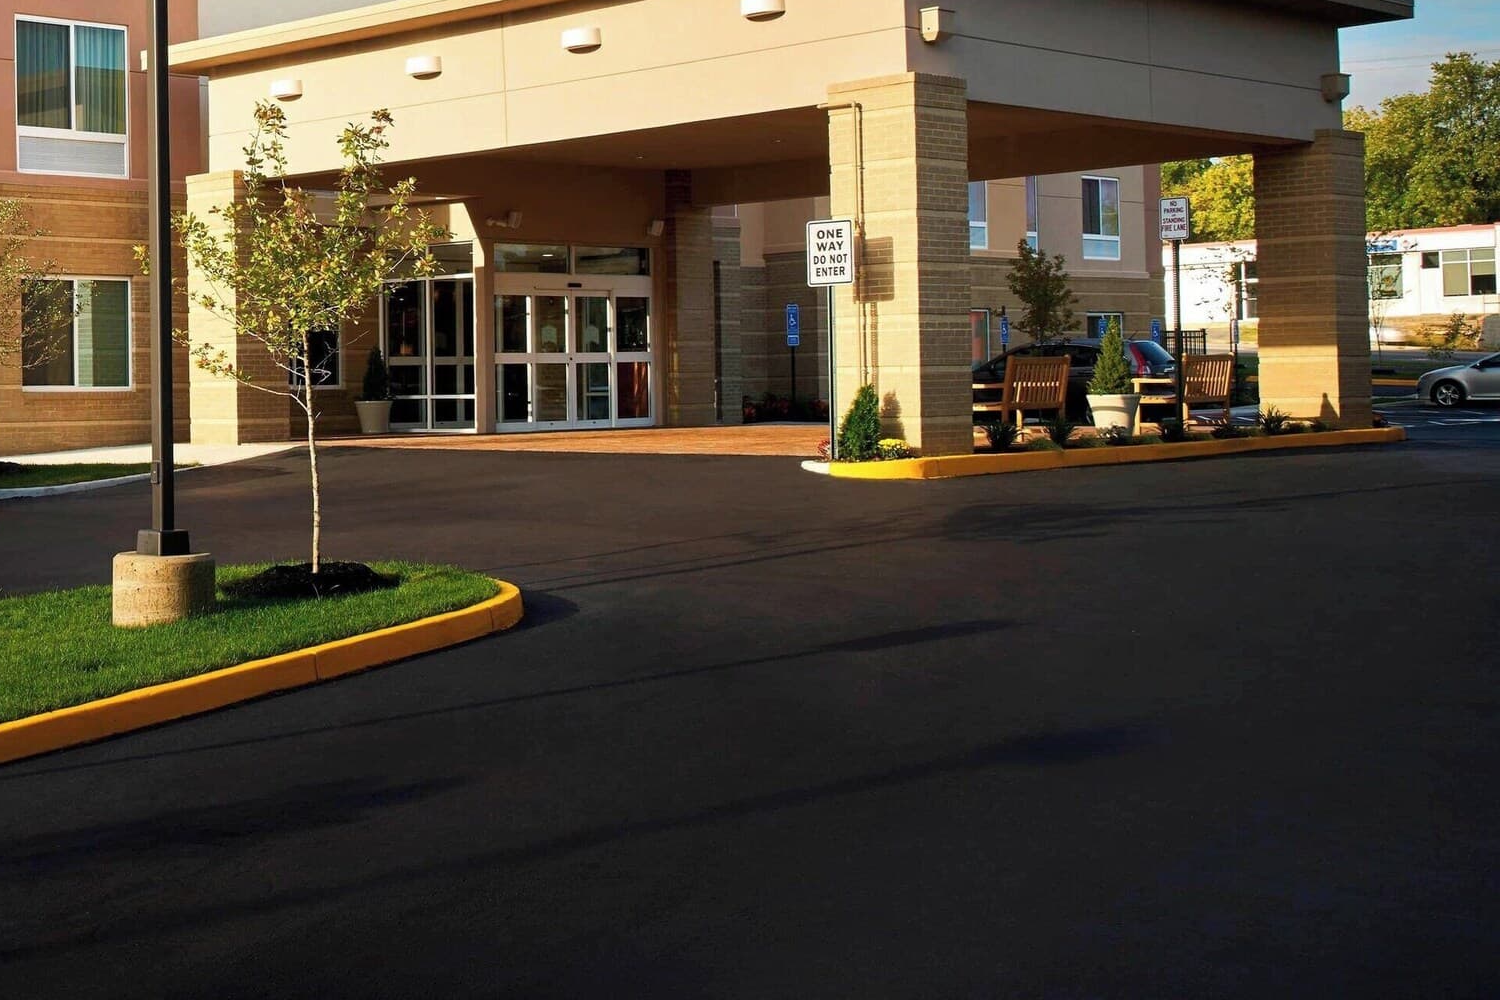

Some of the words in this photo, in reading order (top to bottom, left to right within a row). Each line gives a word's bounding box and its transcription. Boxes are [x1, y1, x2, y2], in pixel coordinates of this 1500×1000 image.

[816, 229, 843, 239] ONE
[816, 241, 844, 252] WAY
[813, 255, 826, 265] DO
[829, 254, 847, 264] NOT
[816, 266, 845, 277] ENTER
